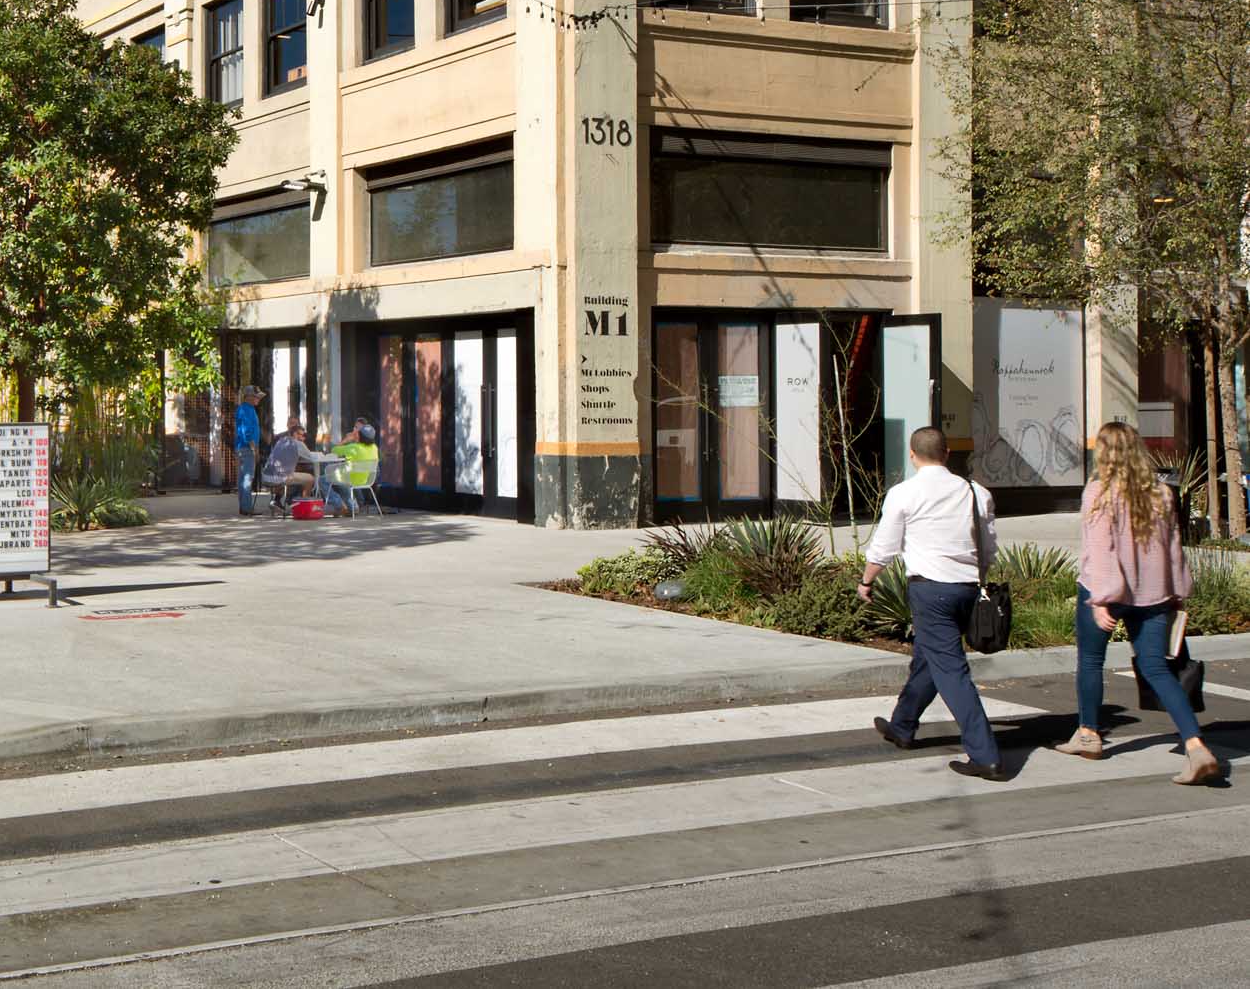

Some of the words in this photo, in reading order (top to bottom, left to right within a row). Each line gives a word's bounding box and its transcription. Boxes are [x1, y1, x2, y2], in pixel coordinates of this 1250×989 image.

[581, 117, 632, 147] 1318
[583, 296, 629, 307] Building
[583, 310, 629, 336] M1
[595, 368, 632, 377] Lobbies
[787, 377, 808, 386] ROW
[581, 385, 610, 394] Shops
[581, 401, 616, 409] Shuttle
[581, 417, 633, 425] Restrooms
[11, 459, 31, 467] BURN
[0, 510, 32, 518] MYRTLE
